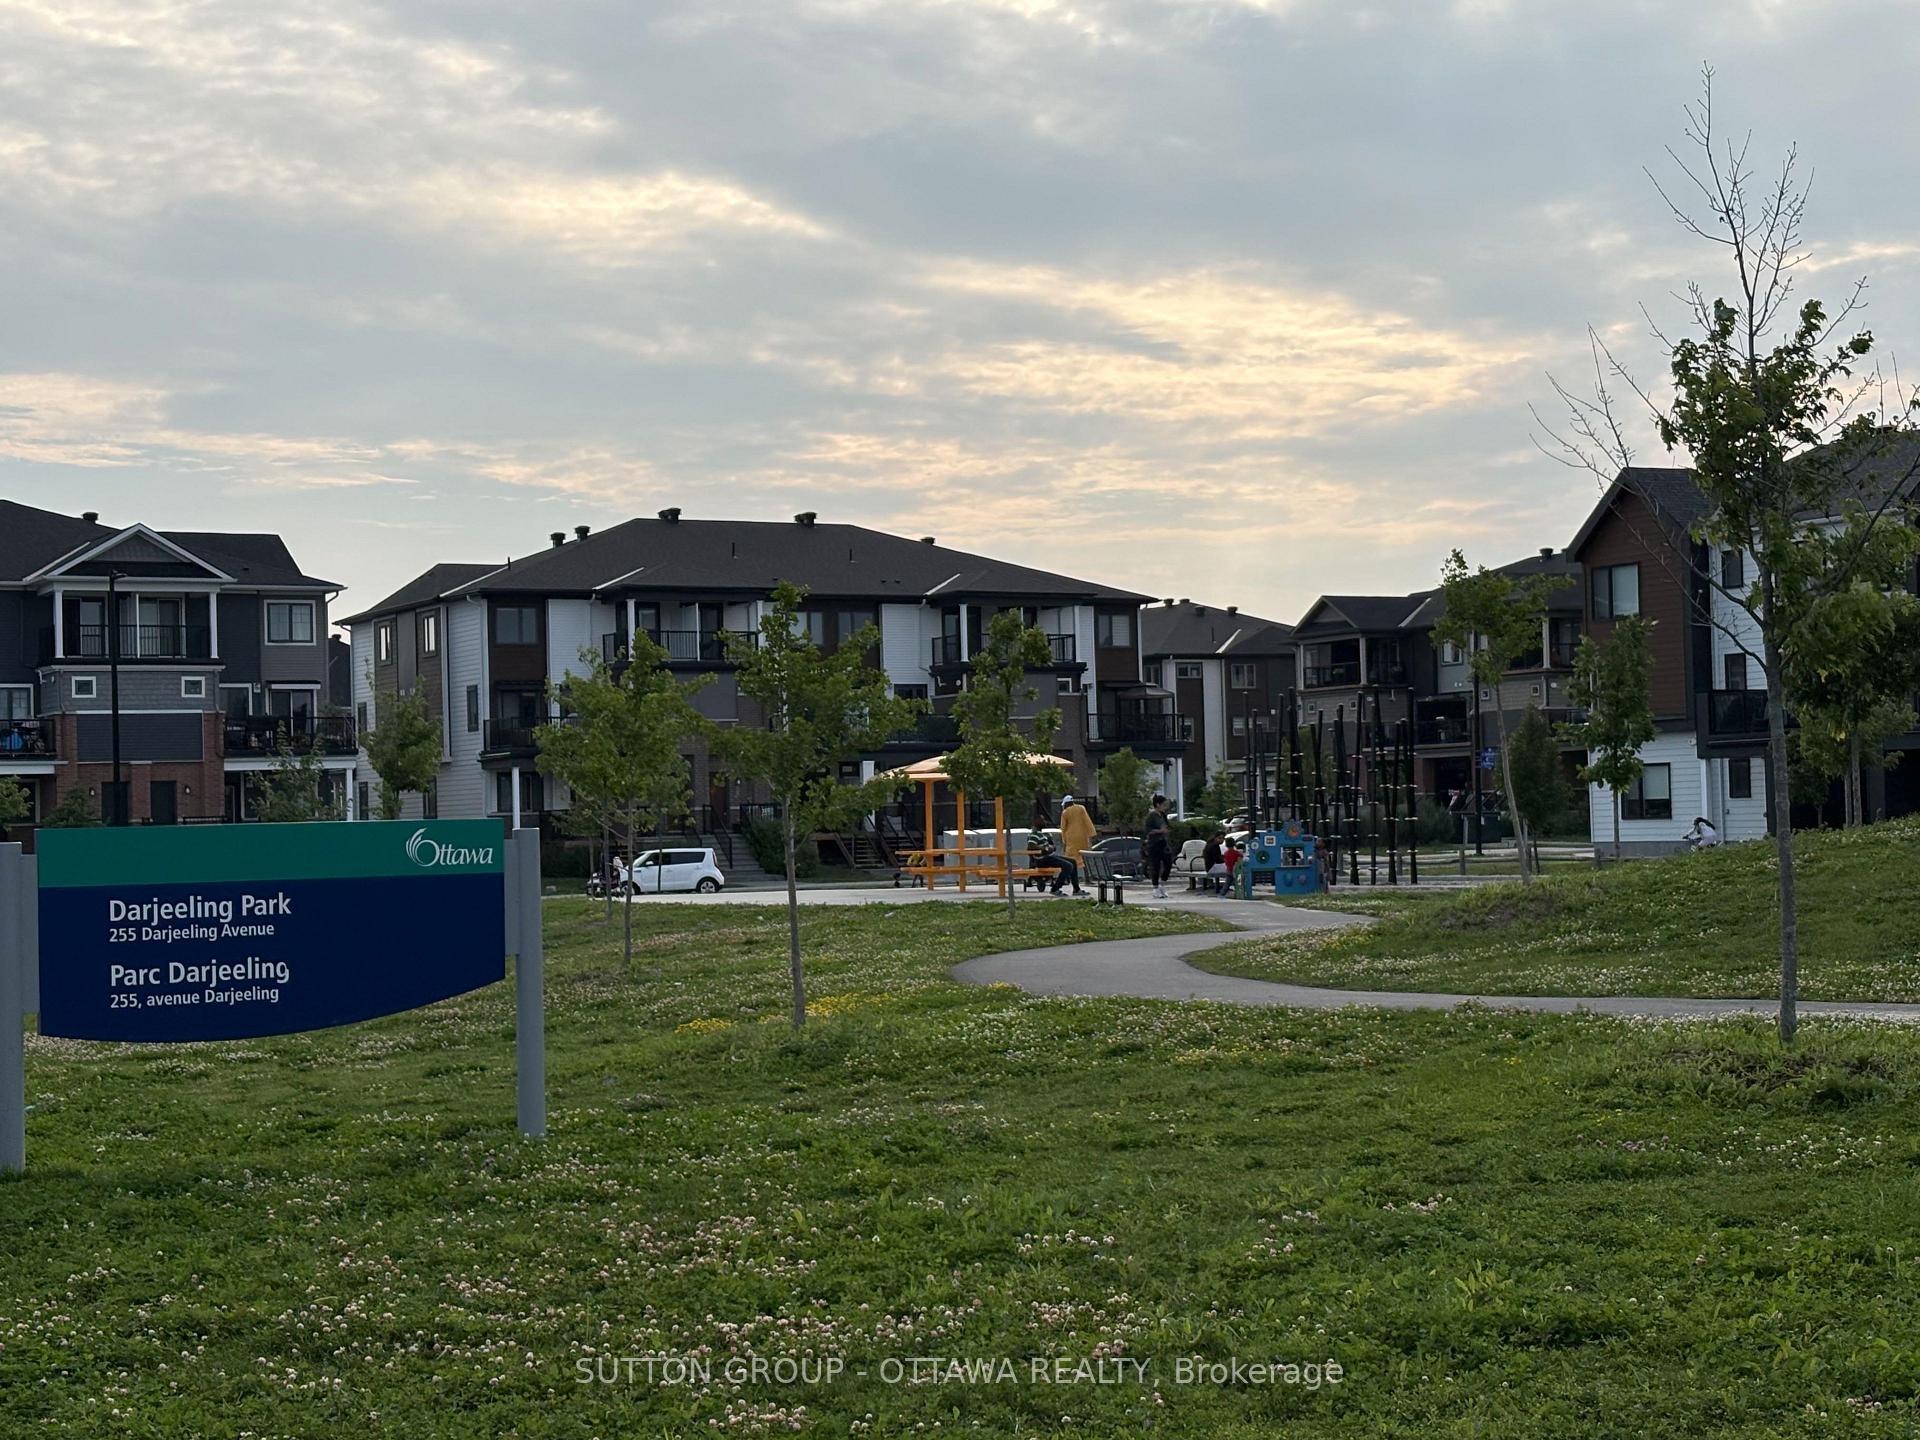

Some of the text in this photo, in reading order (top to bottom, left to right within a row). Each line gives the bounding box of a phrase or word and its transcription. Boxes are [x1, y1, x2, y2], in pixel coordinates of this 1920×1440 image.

[405, 828, 494, 867] Ottawa
[109, 892, 292, 924] Darjeeling Park
[109, 923, 275, 943] 255 Darjeeling Avenue
[110, 957, 290, 988] Parc Darjeeling
[110, 986, 279, 1010] 255, avenue Darjeeling
